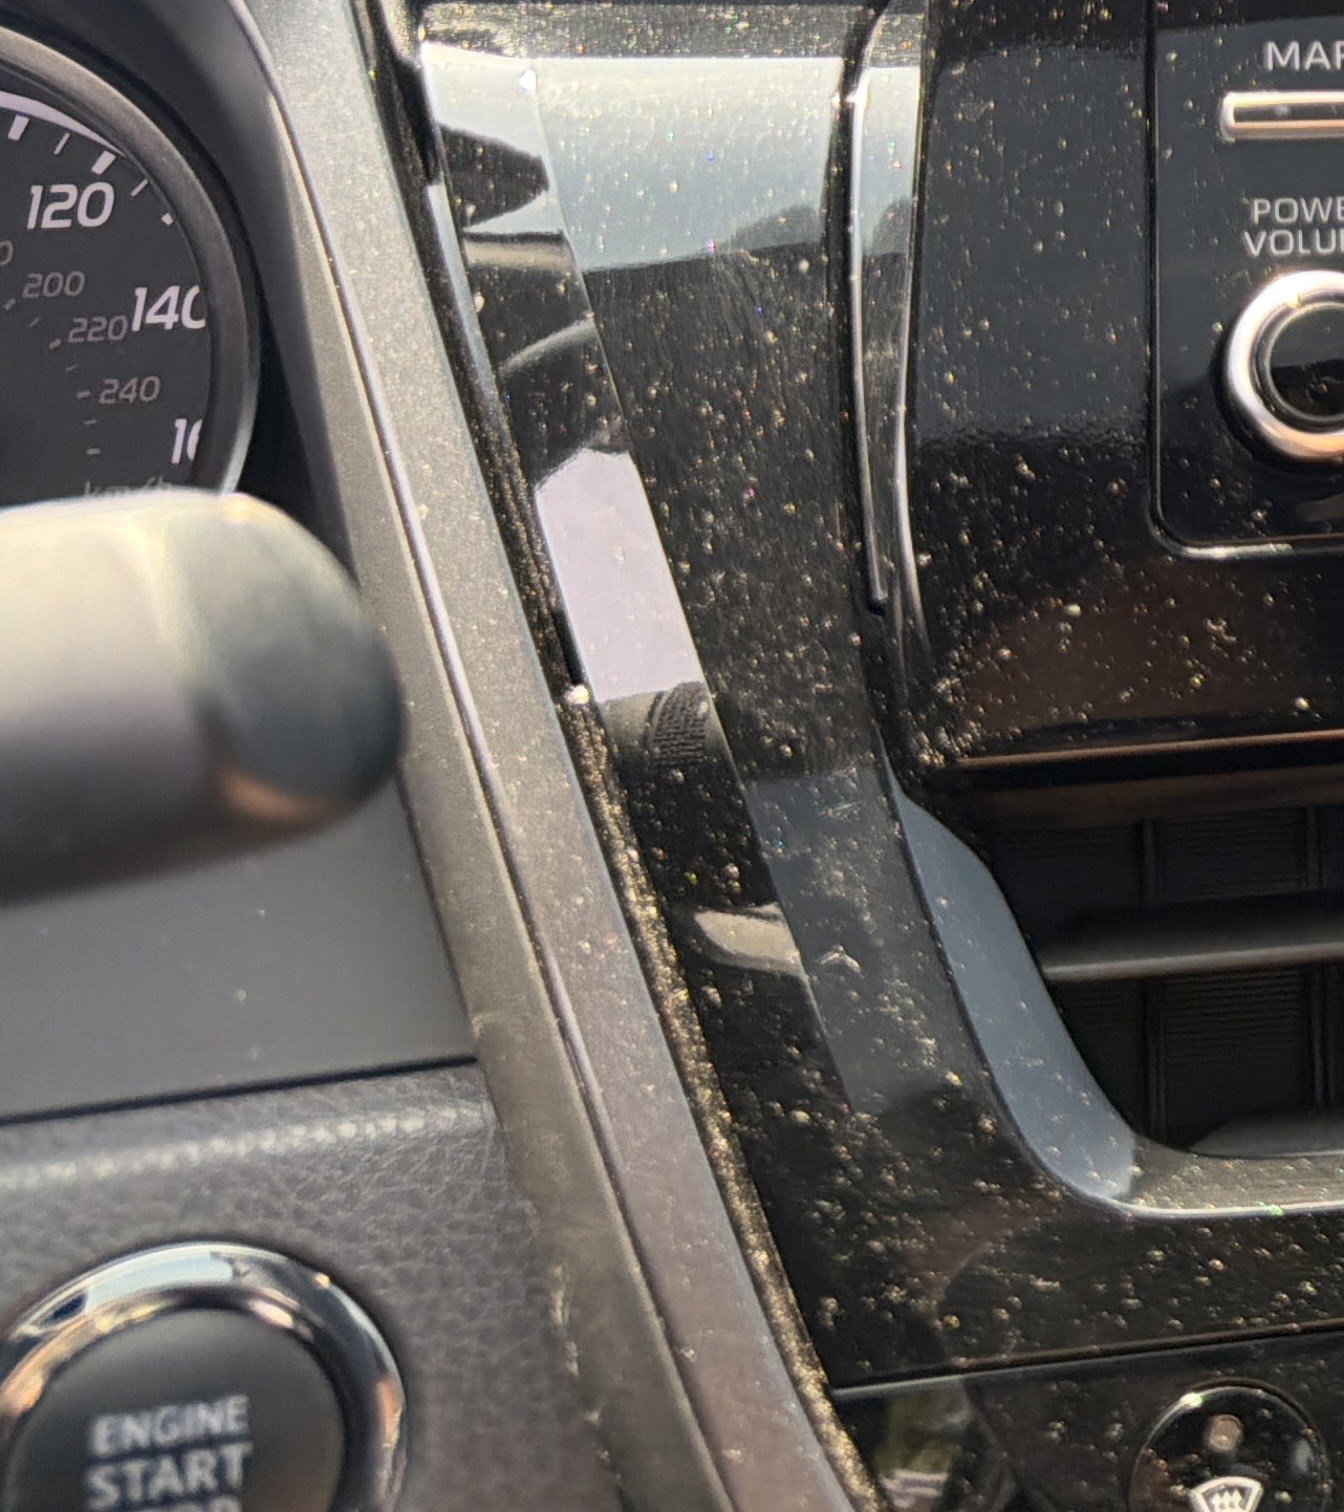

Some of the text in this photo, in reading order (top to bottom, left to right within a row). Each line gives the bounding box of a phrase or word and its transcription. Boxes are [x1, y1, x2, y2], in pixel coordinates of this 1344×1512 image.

[27, 182, 115, 229] 120
[22, 271, 86, 299] 200
[67, 315, 128, 343] 220
[98, 376, 161, 405] 240
[92, 1394, 250, 1457] ENGINE
[87, 1442, 252, 1510] START
